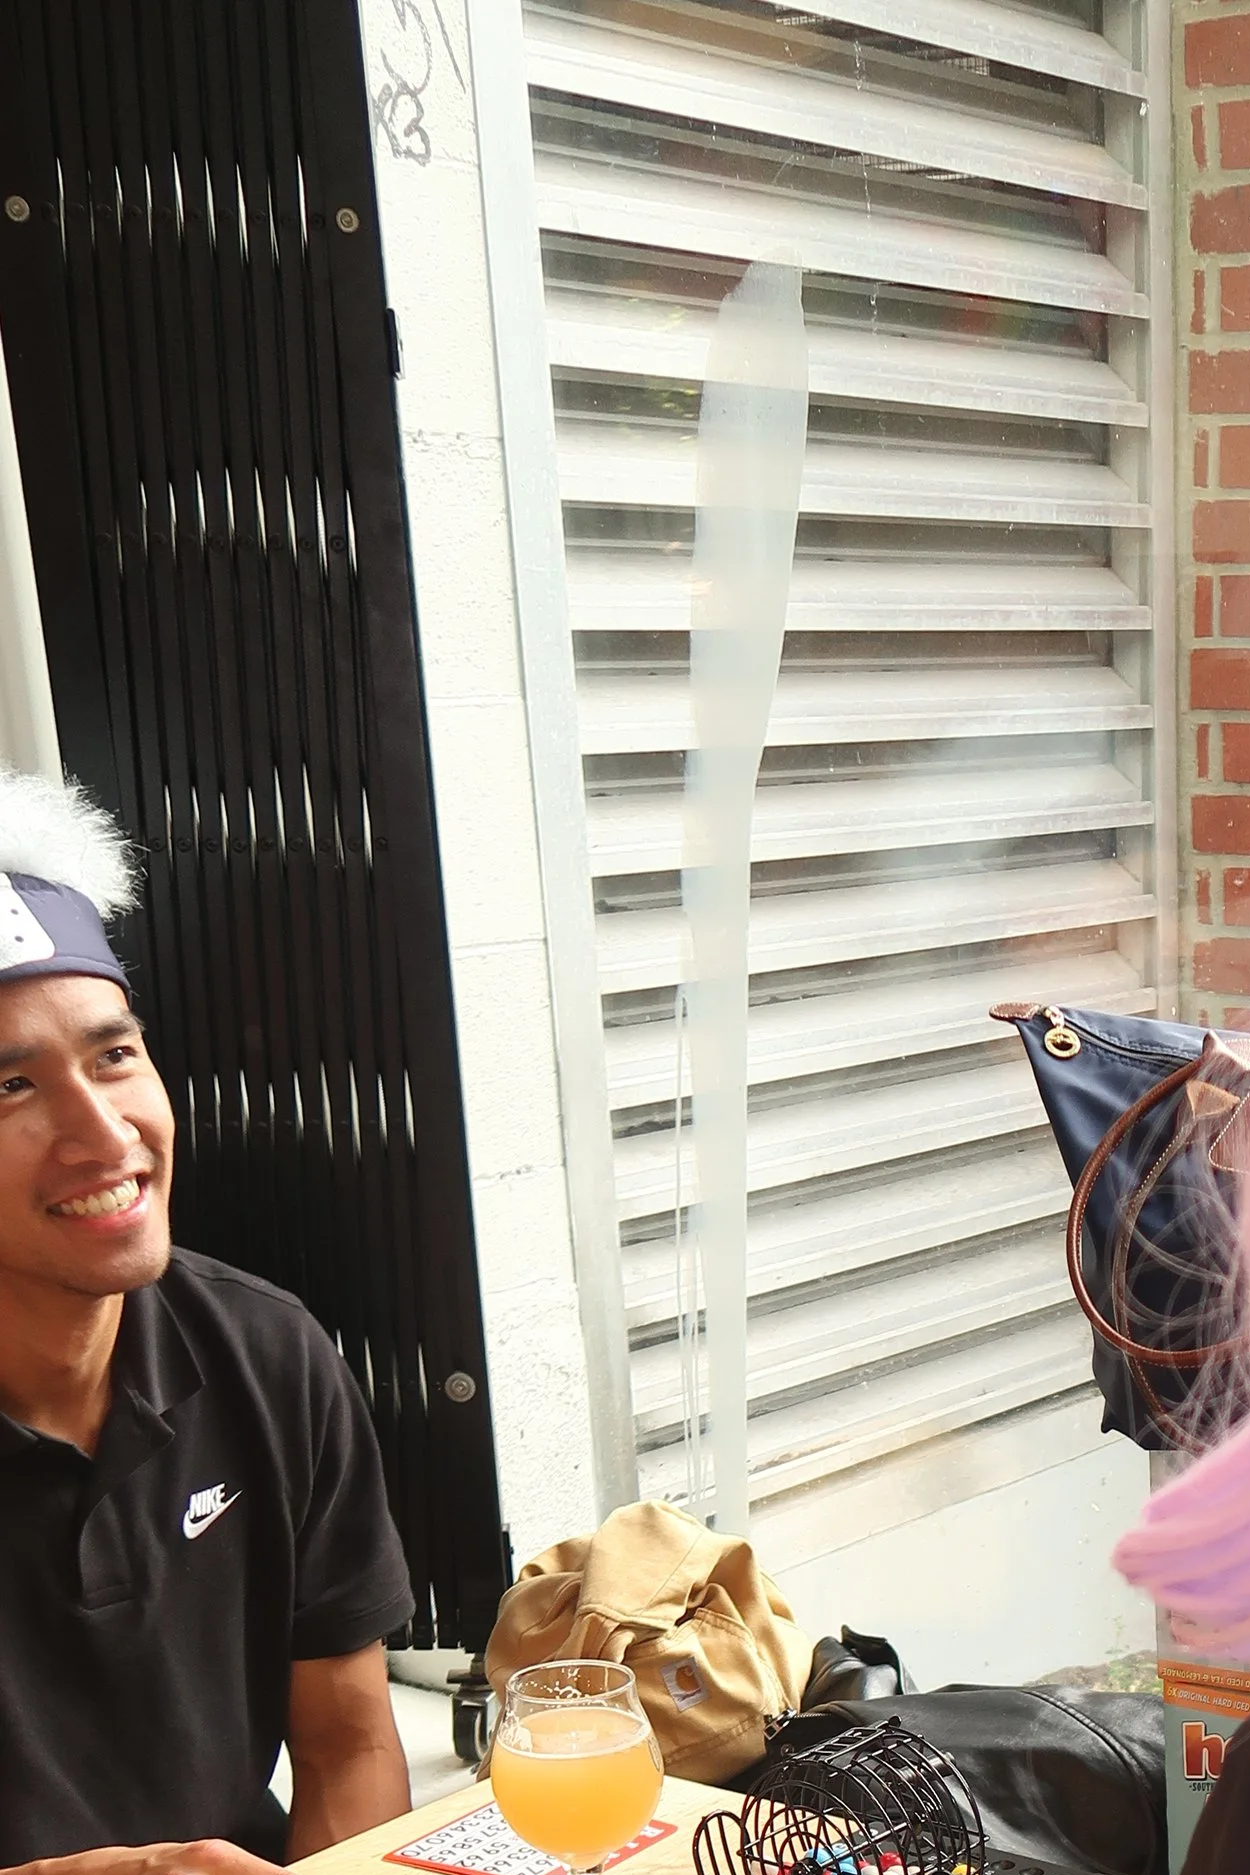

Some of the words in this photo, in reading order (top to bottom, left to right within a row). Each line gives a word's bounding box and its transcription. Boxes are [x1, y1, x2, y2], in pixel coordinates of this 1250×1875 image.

[189, 1483, 226, 1519] NIKE
[1162, 1667, 1201, 1681] LEMONADE
[1210, 1674, 1224, 1682] TEA
[1178, 1689, 1211, 1704] ORIGINAL
[1212, 1697, 1232, 1708] HARD
[1233, 1701, 1250, 1712] ICED
[425, 1832, 454, 1845] 60
[400, 1843, 434, 1857] 70
[428, 1849, 457, 1863] 65
